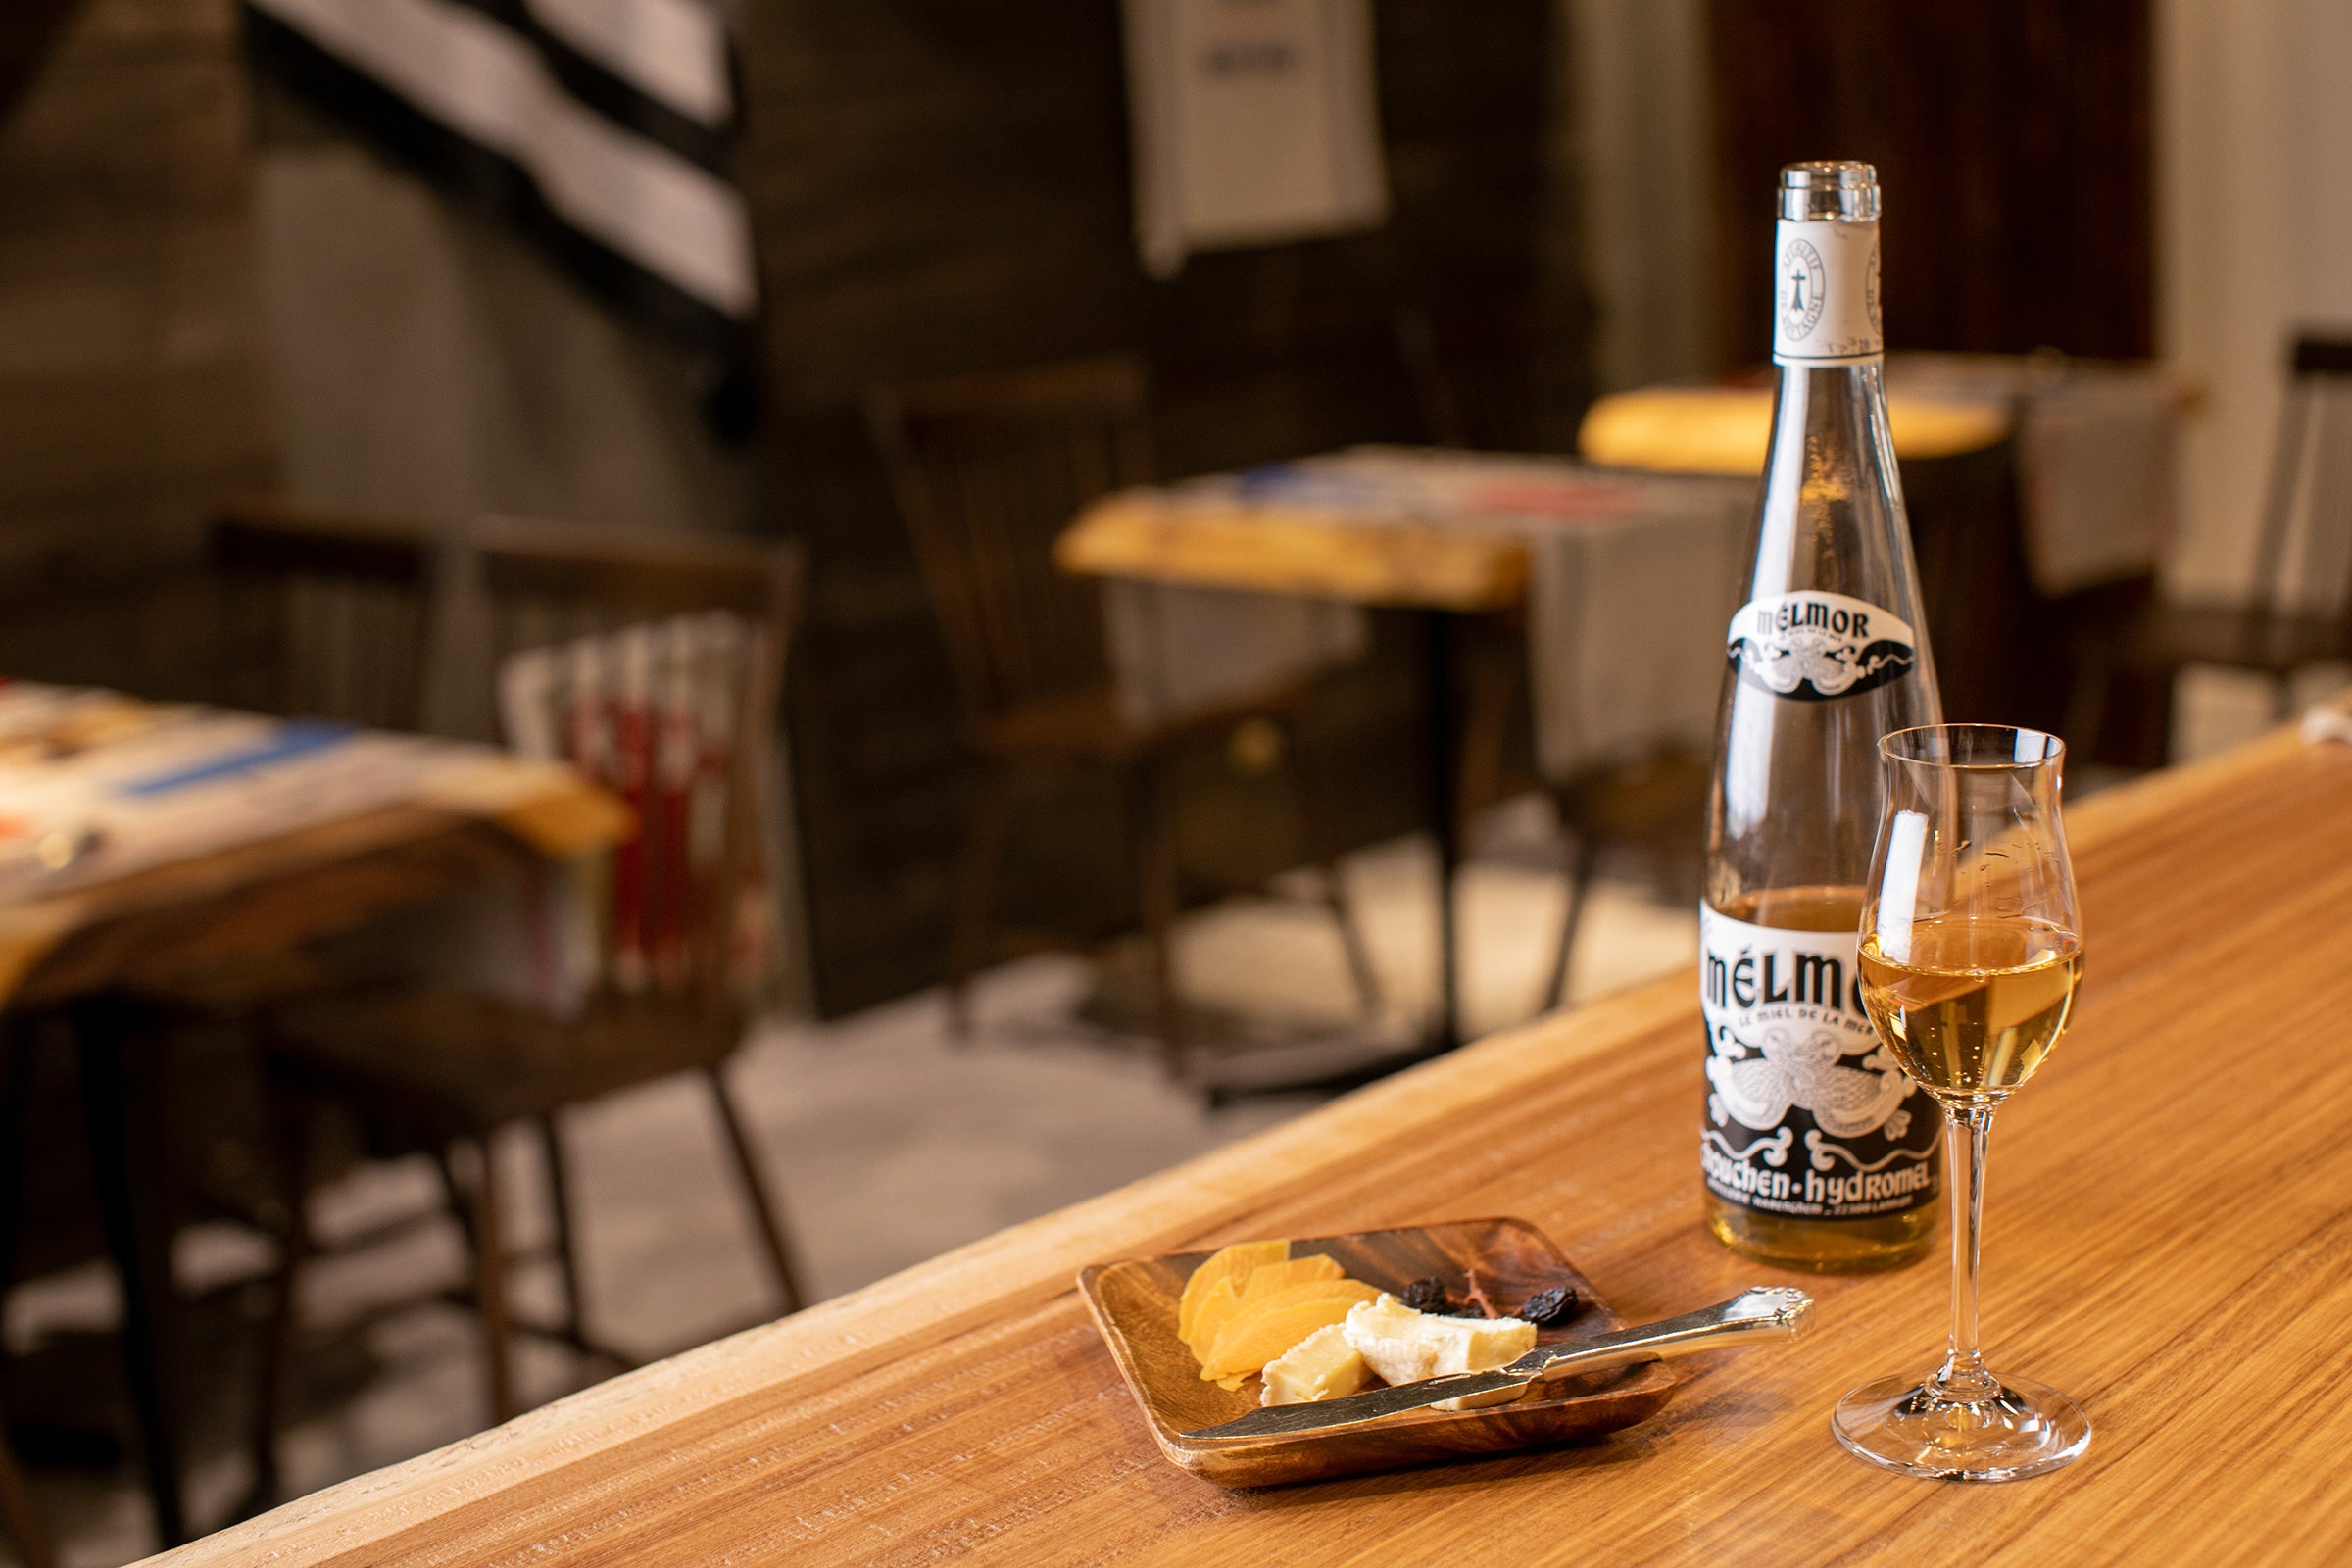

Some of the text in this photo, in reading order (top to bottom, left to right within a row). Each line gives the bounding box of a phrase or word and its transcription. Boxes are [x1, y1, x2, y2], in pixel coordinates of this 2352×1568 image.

[1757, 1007, 1791, 1022] MIEL
[1798, 1007, 1818, 1021] DE
[1822, 1011, 1839, 1027] LA
